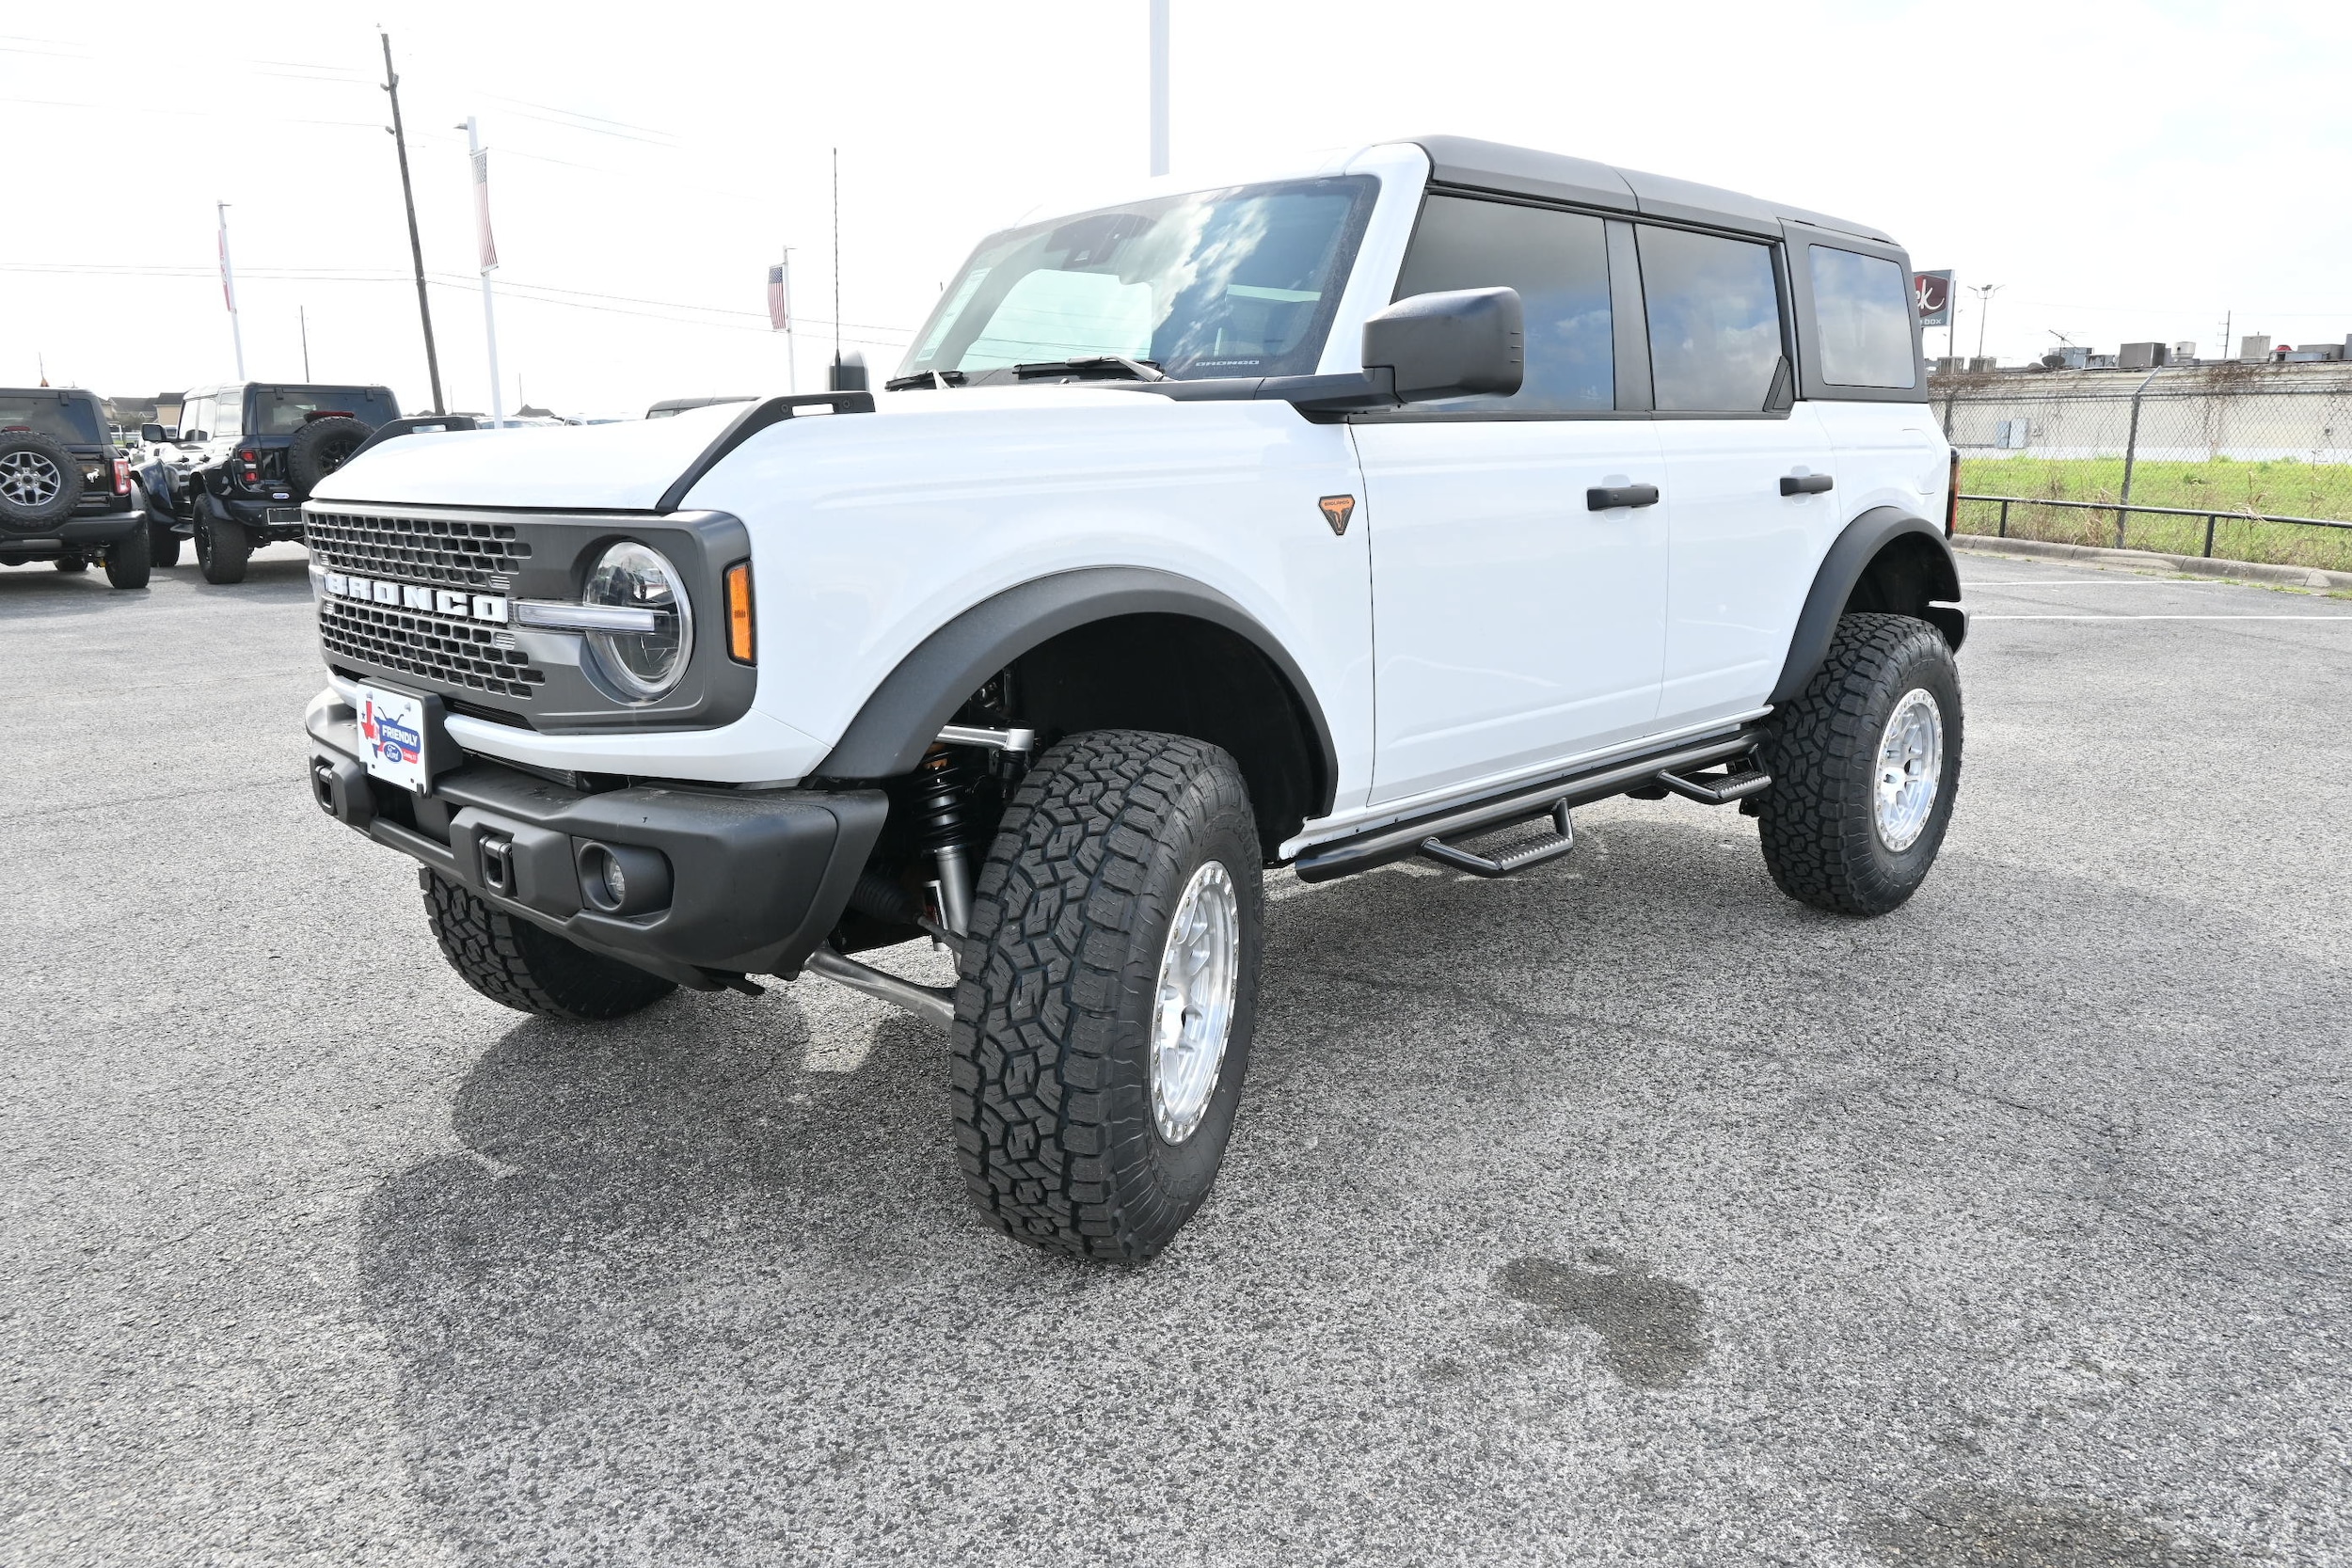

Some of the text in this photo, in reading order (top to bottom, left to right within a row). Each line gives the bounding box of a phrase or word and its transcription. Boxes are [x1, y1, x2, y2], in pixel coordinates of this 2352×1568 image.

[326, 572, 509, 624] BRONCO
[382, 724, 419, 748] FRIENDLY
[386, 744, 400, 761] Ford
